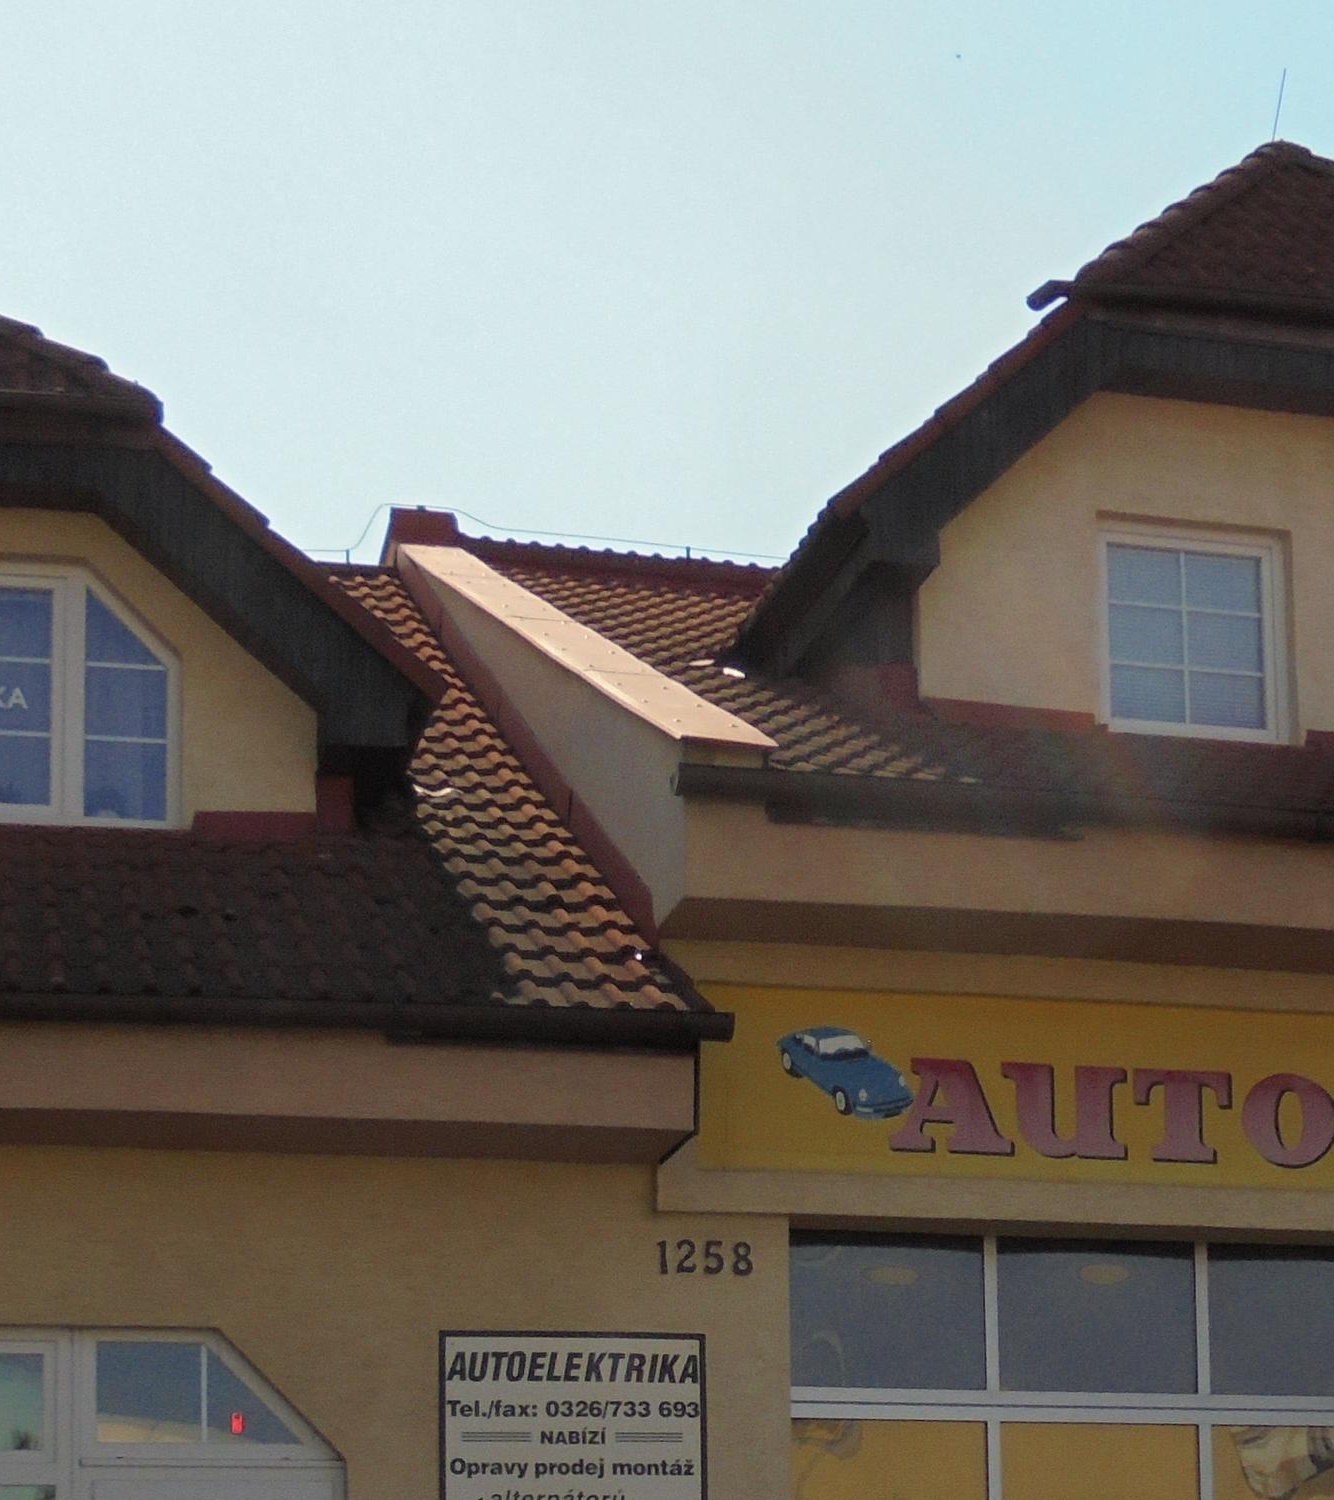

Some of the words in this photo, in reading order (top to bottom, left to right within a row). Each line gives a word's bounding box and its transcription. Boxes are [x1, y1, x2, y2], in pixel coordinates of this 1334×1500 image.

[657, 1239, 753, 1276] 1258
[447, 1351, 699, 1384] AUTOELEKTRIKA
[447, 1400, 538, 1419] Tel./fax:
[545, 1400, 651, 1419] 0326/733
[659, 1401, 700, 1419] 693
[540, 1427, 606, 1445] NABÍZÍ
[450, 1458, 528, 1478] Opravy
[534, 1459, 605, 1478] prodej
[612, 1459, 695, 1476] montáž
